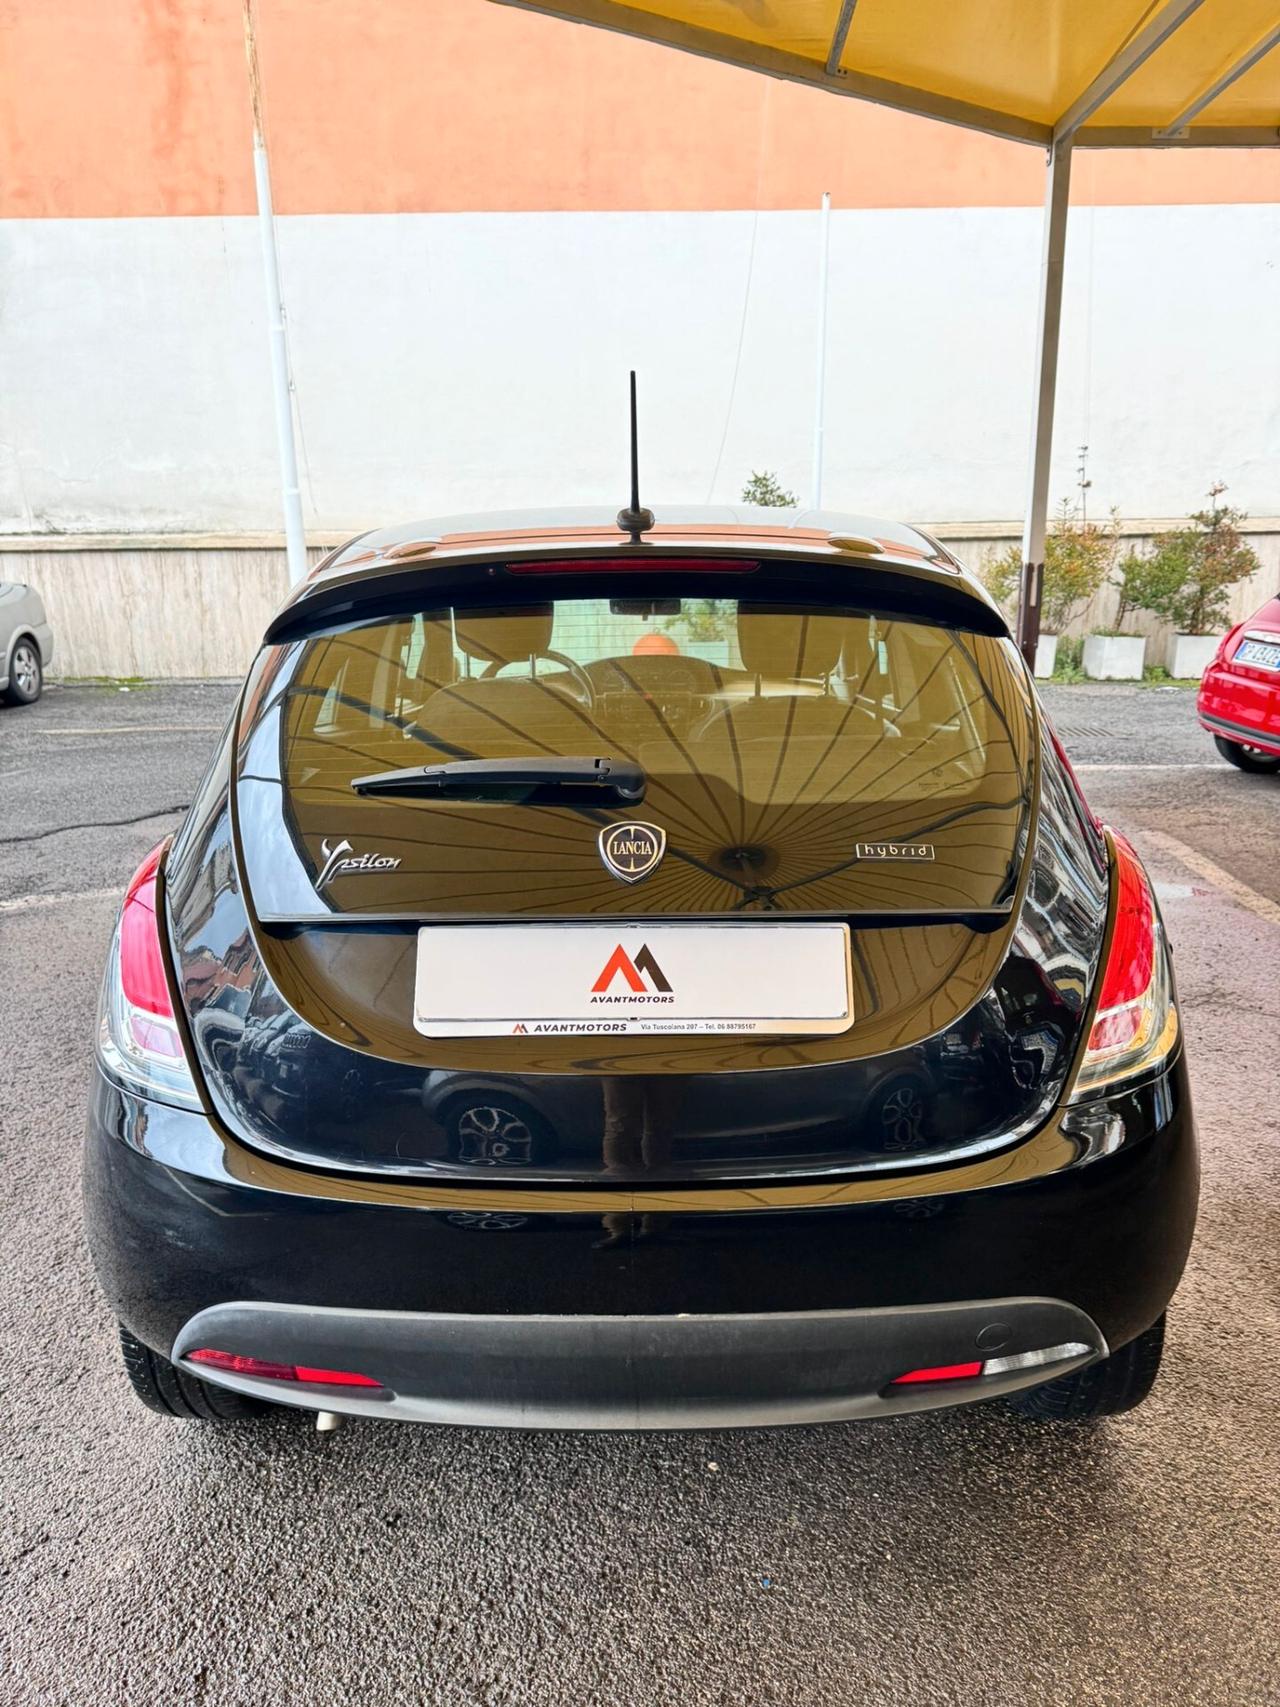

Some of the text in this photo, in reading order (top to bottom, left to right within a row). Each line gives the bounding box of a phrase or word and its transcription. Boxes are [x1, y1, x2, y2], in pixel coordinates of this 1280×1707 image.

[613, 841, 652, 855] LANCIA
[864, 844, 927, 858] hybrid
[315, 838, 402, 891] Ypsilon
[534, 1023, 627, 1032] AVANTMOTORS
